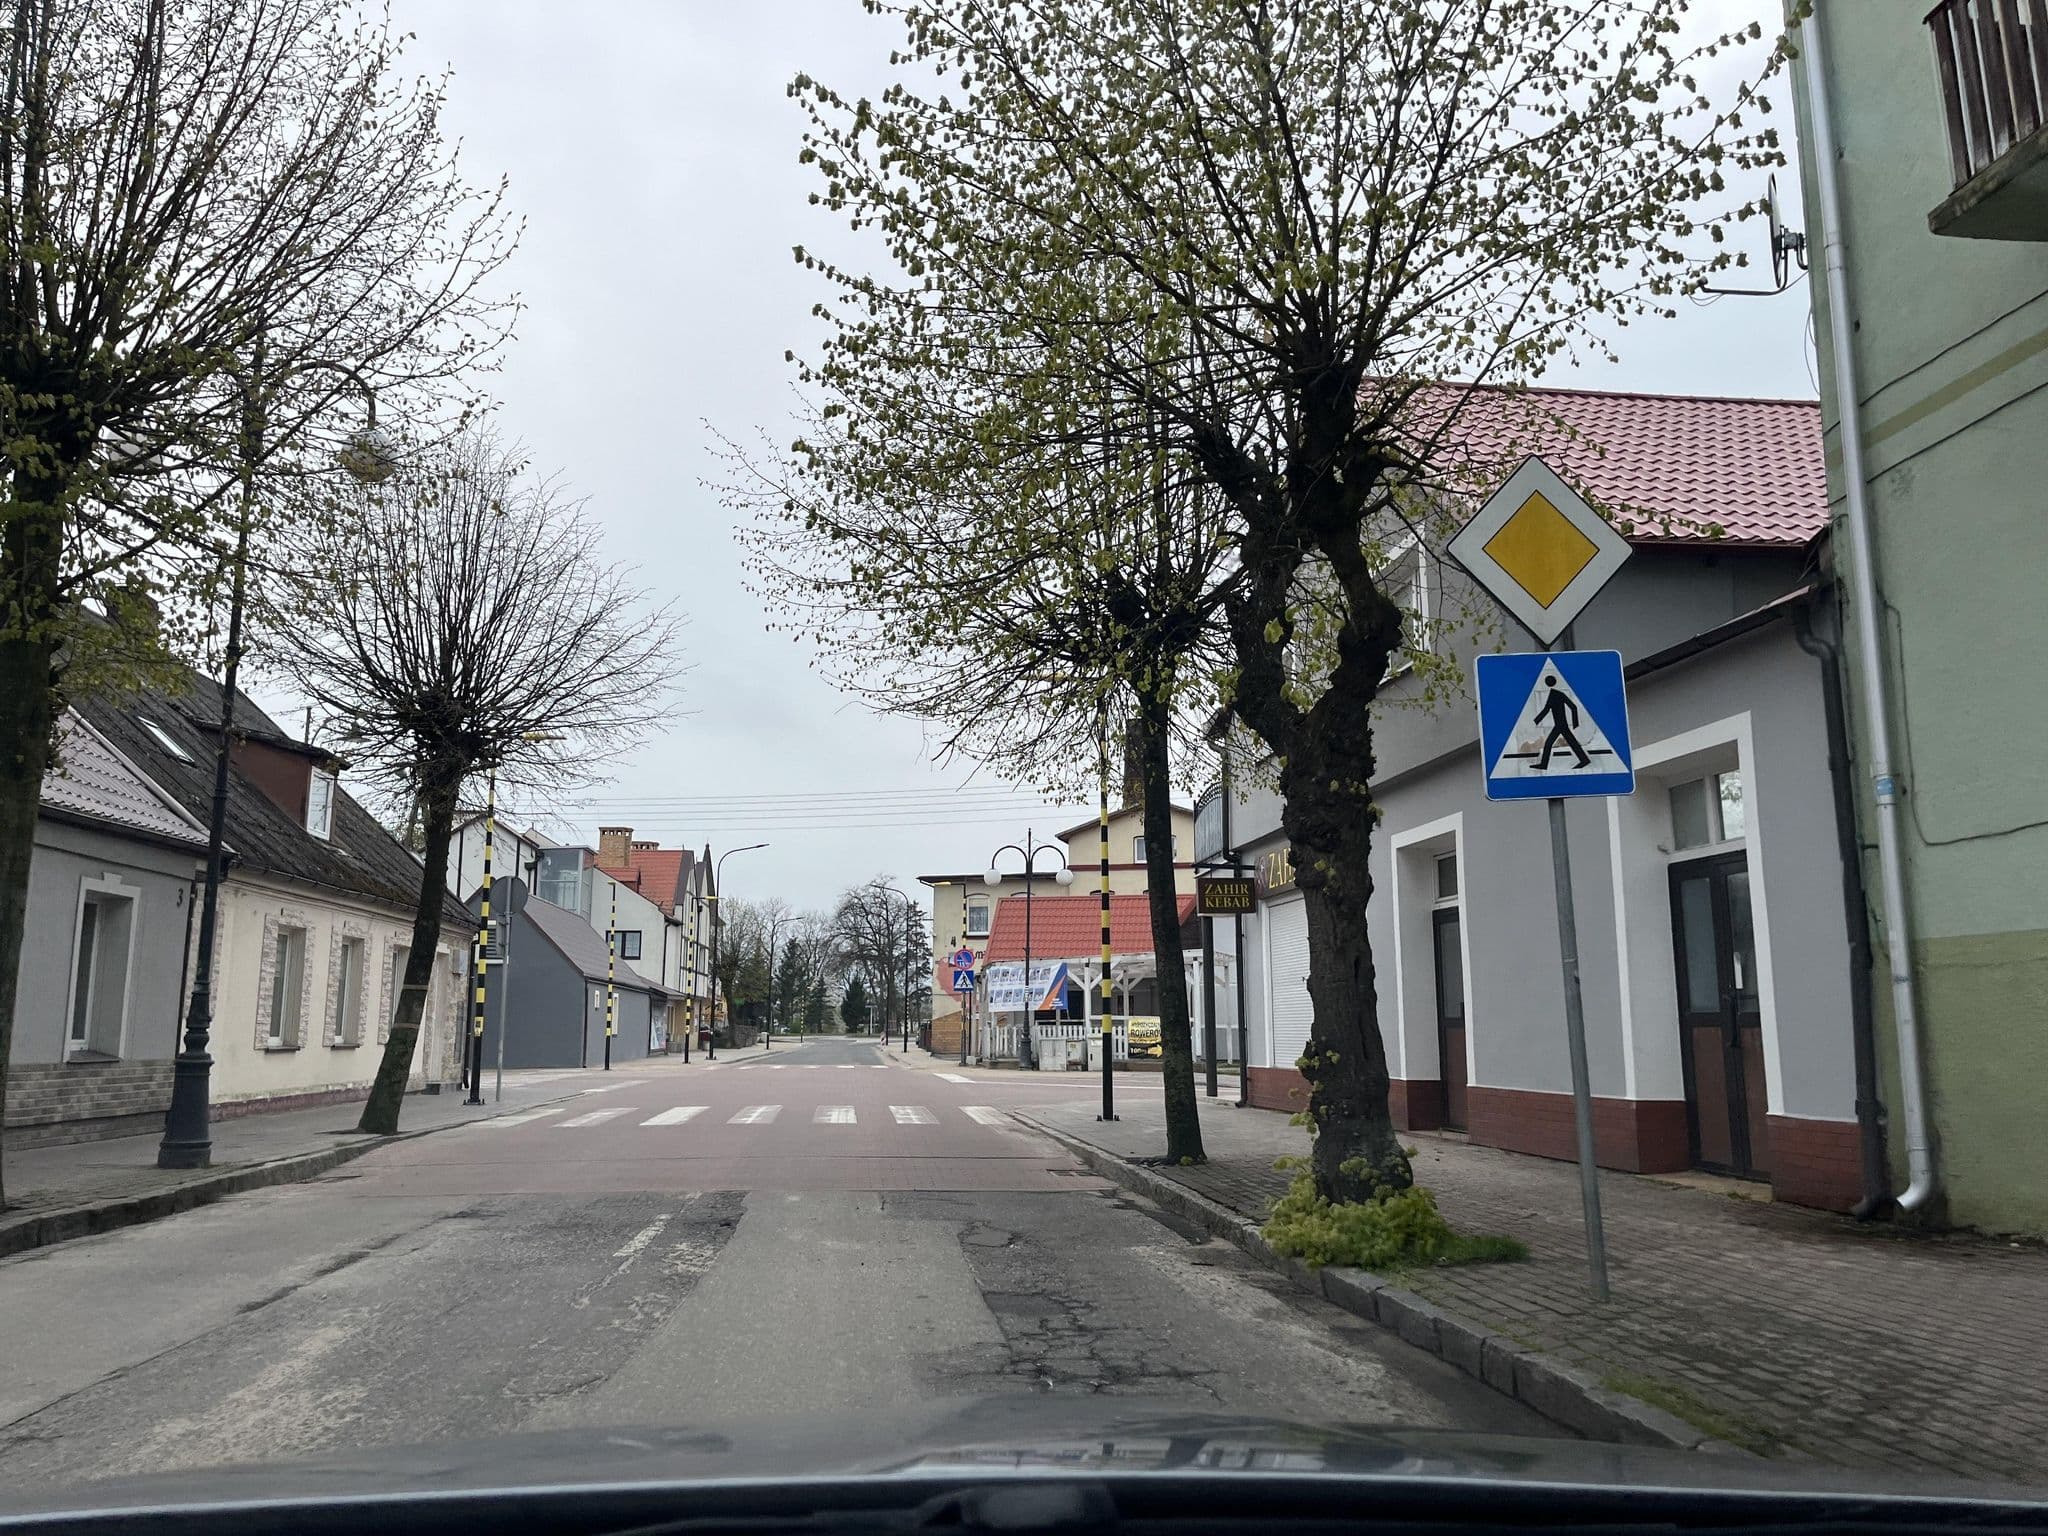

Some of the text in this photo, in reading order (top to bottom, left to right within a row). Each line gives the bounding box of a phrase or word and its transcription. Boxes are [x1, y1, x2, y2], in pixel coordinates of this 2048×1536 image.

[1269, 848, 1296, 889] ZAH
[1205, 884, 1249, 894] ZAHIR
[176, 887, 184, 908] 3
[1205, 896, 1250, 908] KEBAB
[950, 936, 957, 948] 4
